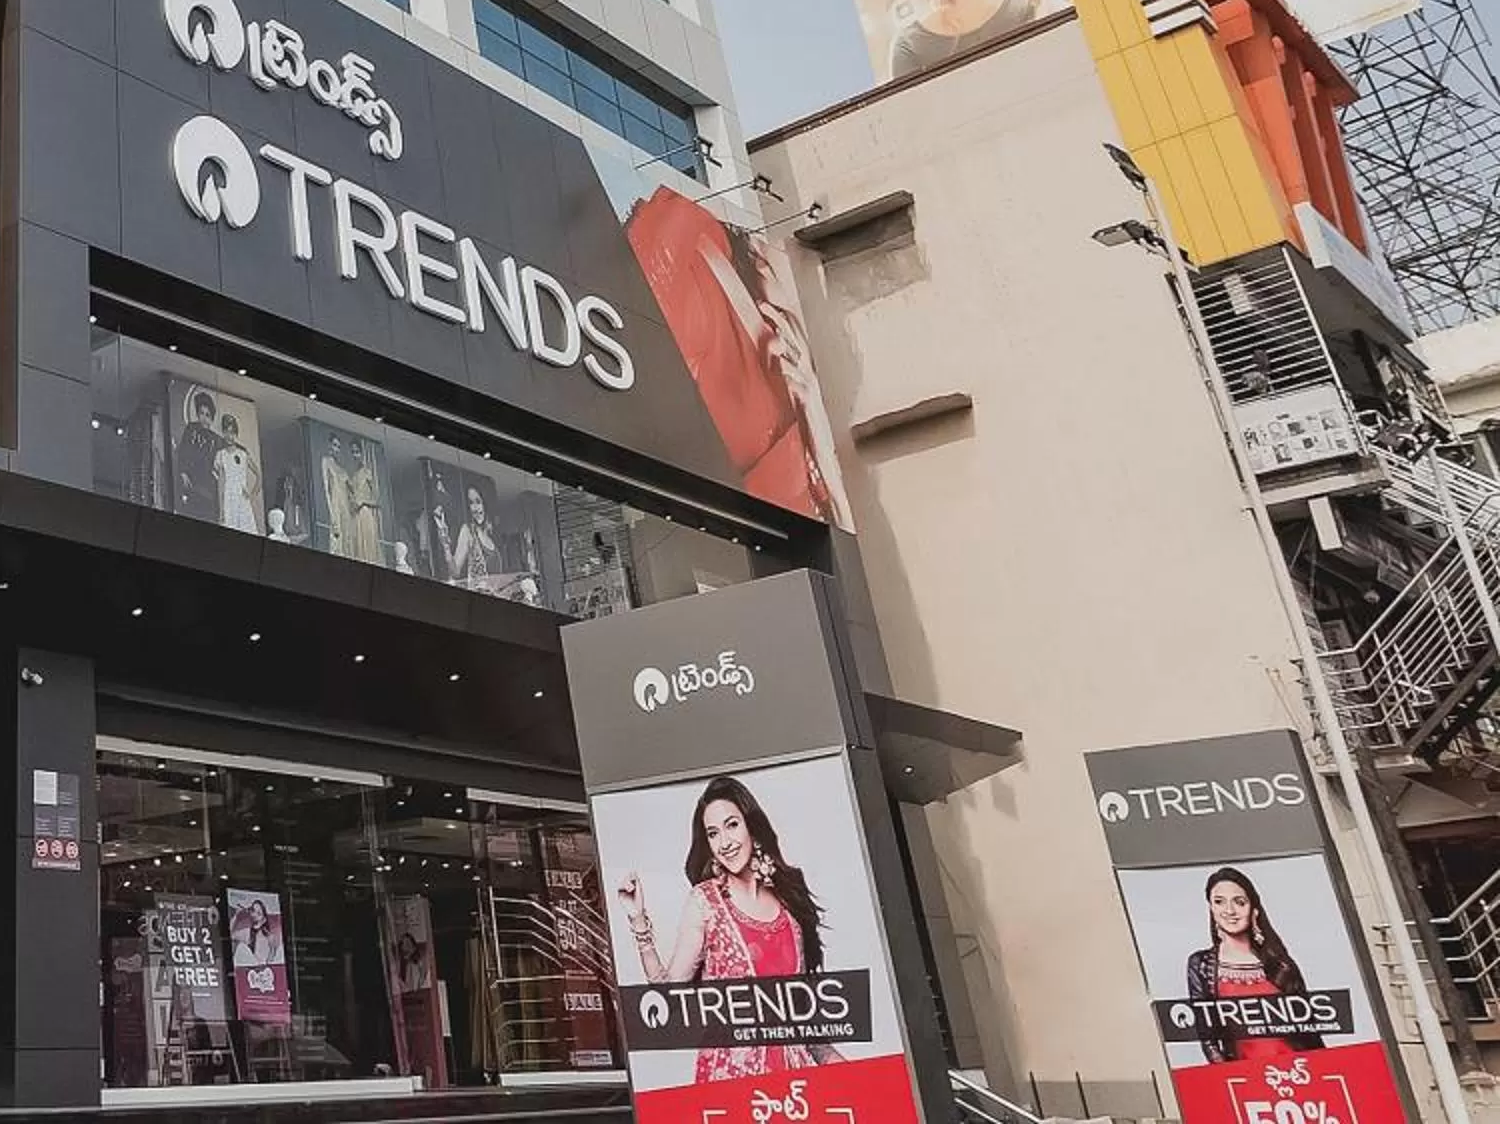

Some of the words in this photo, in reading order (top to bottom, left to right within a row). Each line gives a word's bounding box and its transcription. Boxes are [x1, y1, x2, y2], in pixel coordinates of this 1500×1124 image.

[260, 143, 635, 391] TRENDS
[1129, 774, 1305, 820] TRENDS
[167, 925, 196, 943] BUY
[201, 927, 212, 945] 2
[171, 946, 200, 964] GET
[205, 947, 215, 965] 1
[174, 966, 219, 986] FREE
[669, 979, 850, 1027] TRENDS
[1193, 995, 1337, 1027] TRENDS
[733, 1028, 757, 1041] GET
[760, 1026, 795, 1040] THEM
[800, 1023, 854, 1037] TALKING
